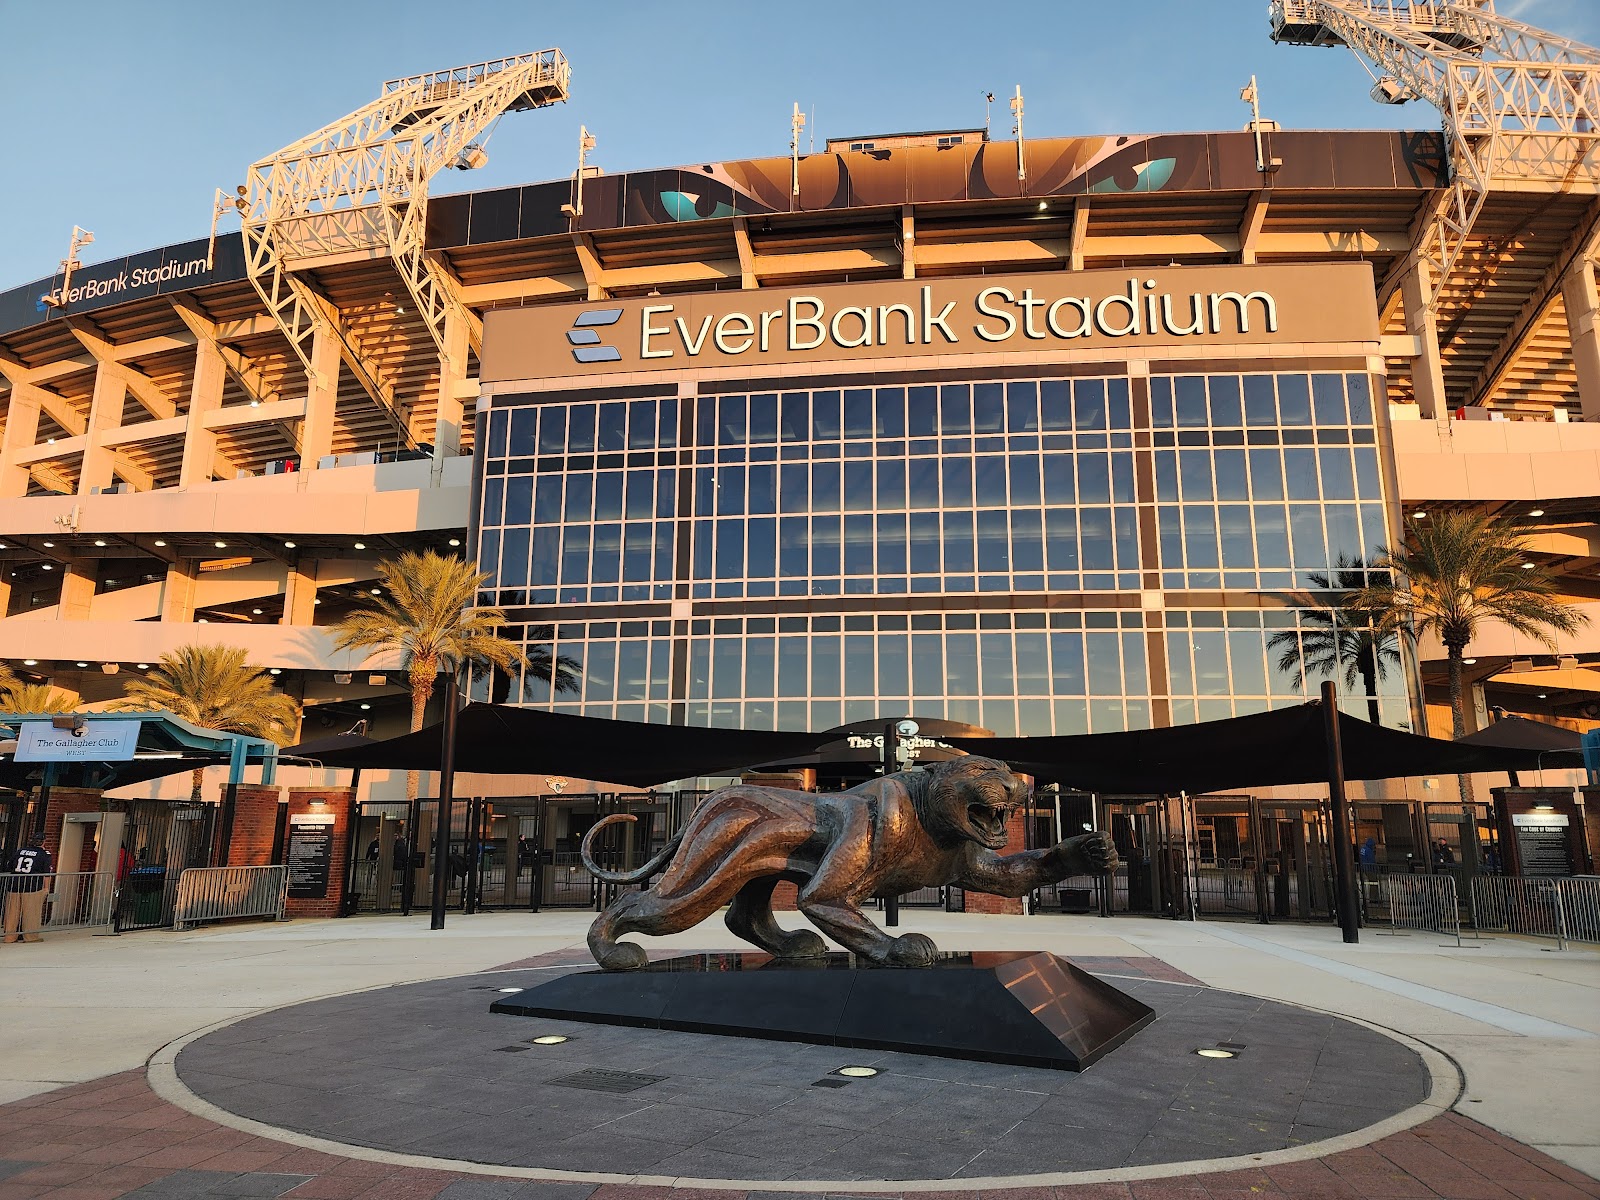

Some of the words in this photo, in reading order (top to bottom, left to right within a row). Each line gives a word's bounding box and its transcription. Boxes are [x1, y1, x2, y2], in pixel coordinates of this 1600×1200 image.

[130, 258, 206, 288] Stadium
[641, 285, 959, 359] EverBank
[973, 278, 1278, 343] Stadium
[55, 739, 97, 748] Gallagher
[98, 738, 119, 747] Club
[847, 736, 872, 748] The
[873, 735, 935, 749] Gagher
[15, 857, 33, 873] 13
